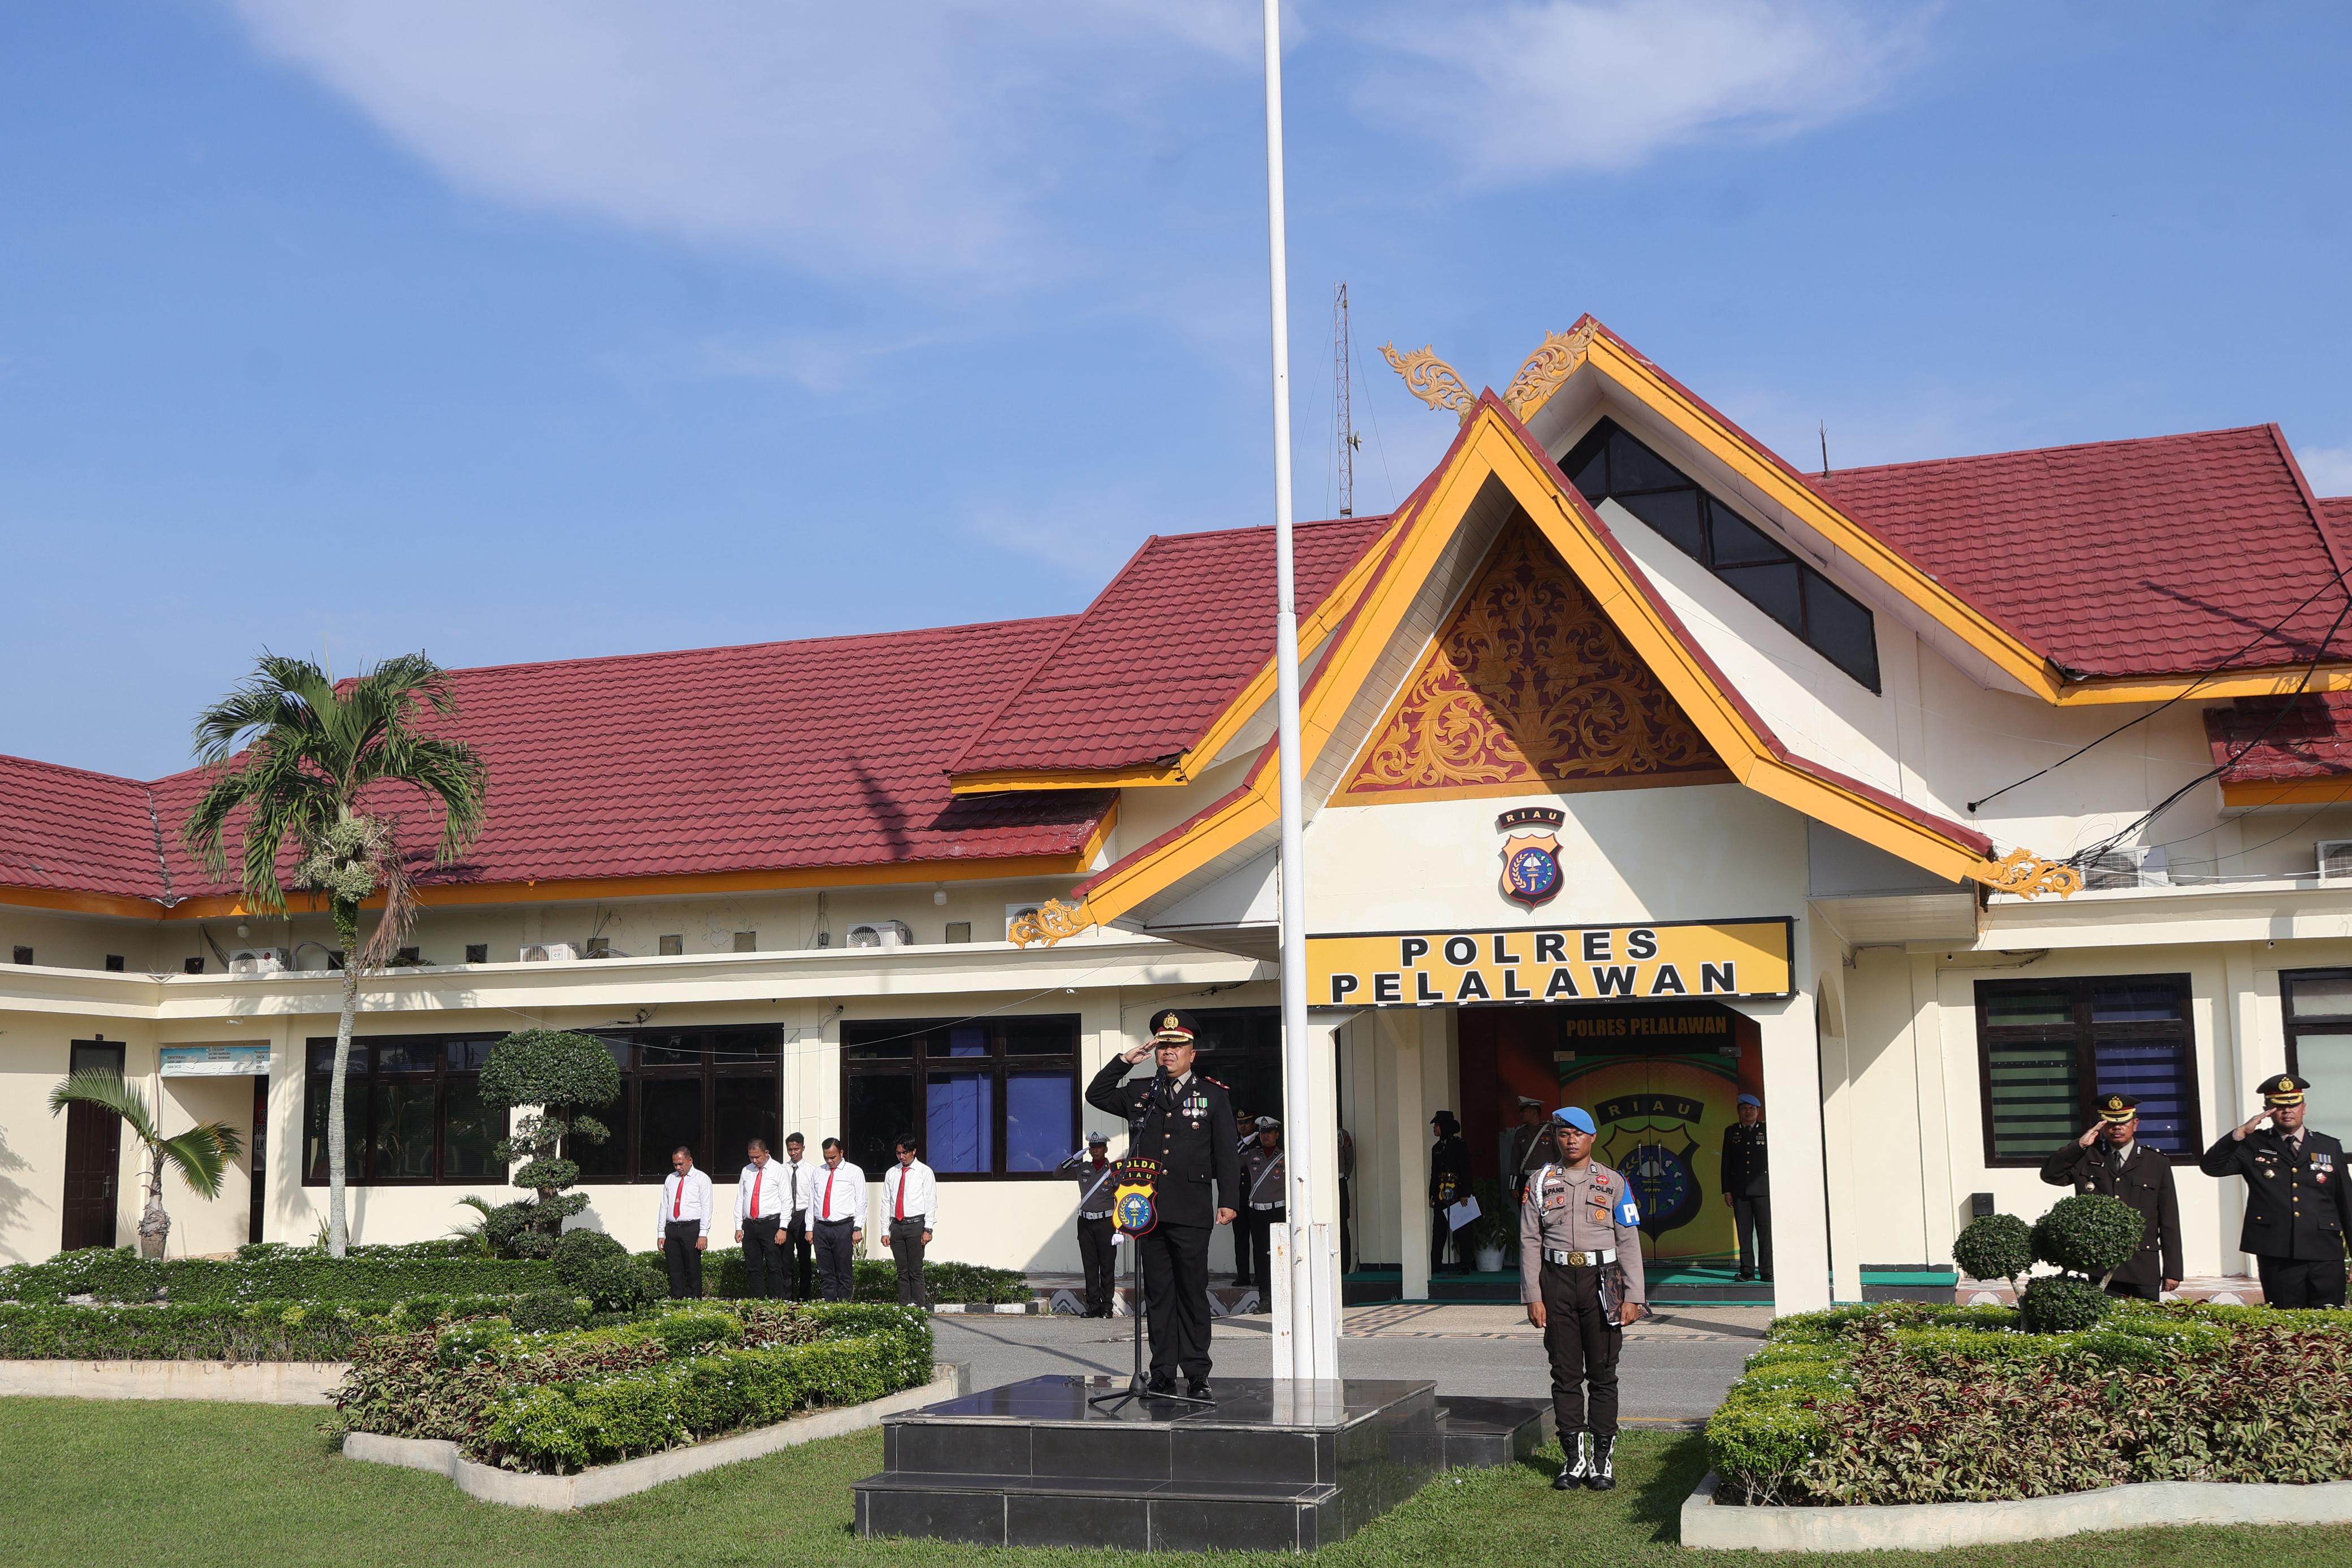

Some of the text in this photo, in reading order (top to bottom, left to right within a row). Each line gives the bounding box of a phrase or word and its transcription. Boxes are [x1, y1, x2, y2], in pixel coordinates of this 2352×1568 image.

[1506, 811, 1557, 822] RIAU
[1400, 929, 1659, 968] POLRES
[1330, 960, 1737, 1004] PELALAWAN
[1566, 1016, 1727, 1037] POLRES PELALAWAN
[1608, 1100, 1690, 1116] RIAU
[1116, 1160, 1156, 1170] POLDA
[1589, 1185, 1614, 1194] POLRI
